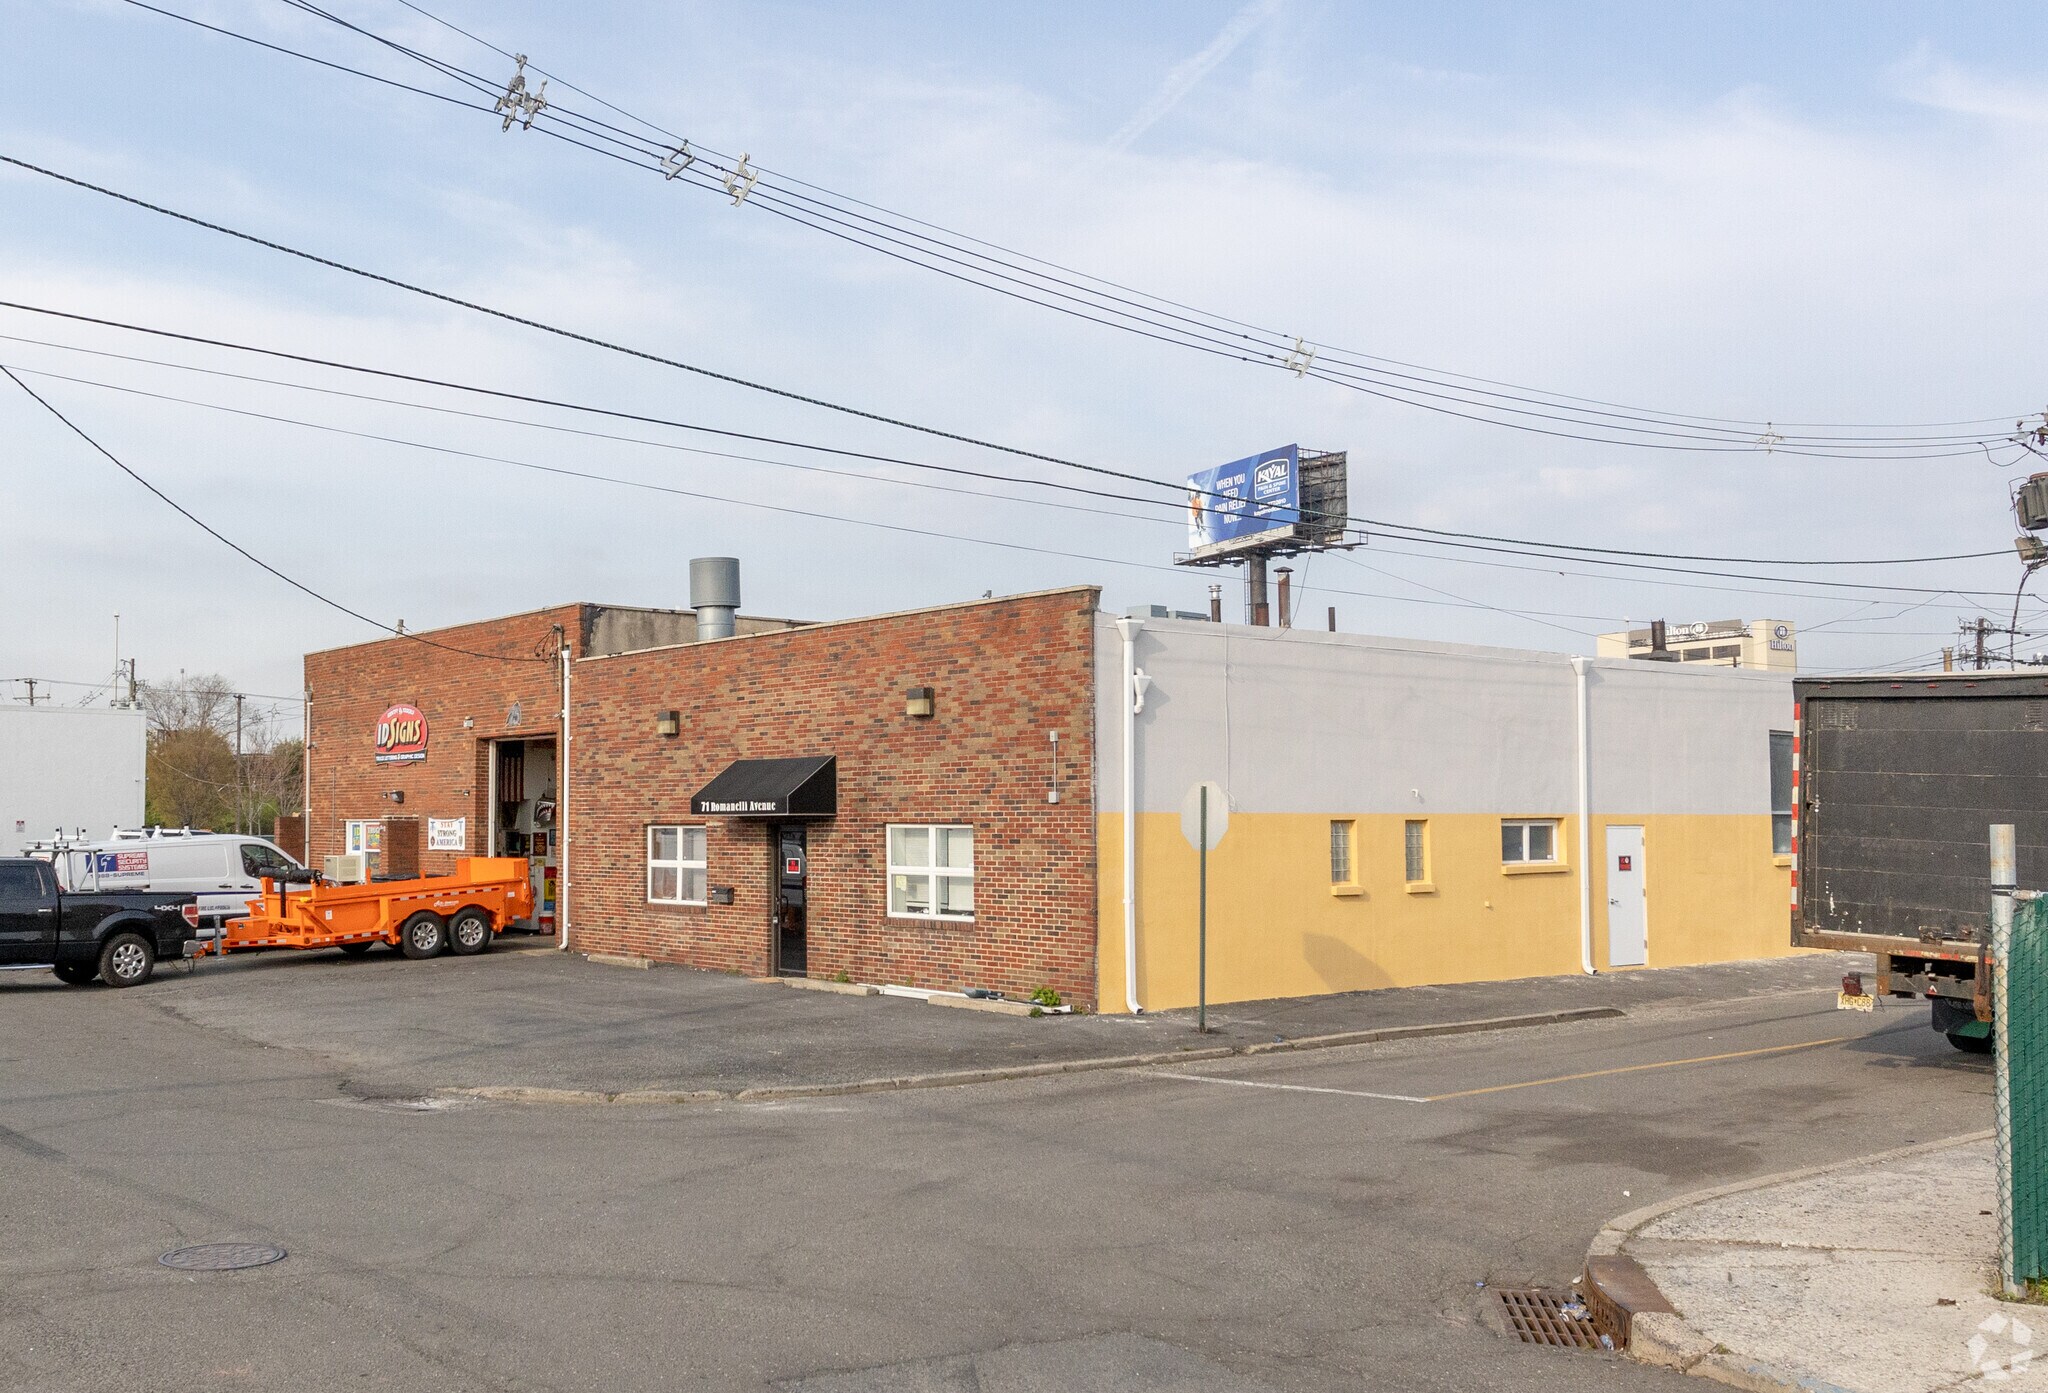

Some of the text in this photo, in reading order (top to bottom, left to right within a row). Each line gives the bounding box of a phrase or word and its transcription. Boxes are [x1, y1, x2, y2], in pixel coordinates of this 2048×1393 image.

[1257, 465, 1287, 483] KAYAL
[1216, 472, 1246, 491] WHEN YOU
[1223, 487, 1239, 501] NEED
[1263, 486, 1281, 495] CENTER
[1215, 502, 1228, 515] PAIN
[1229, 497, 1248, 511] RELIEF
[1665, 624, 1690, 636] ilton
[1771, 640, 1793, 651] Hilton
[701, 801, 776, 812] 71 Romanelli Avenue
[436, 838, 458, 846] AMERICA
